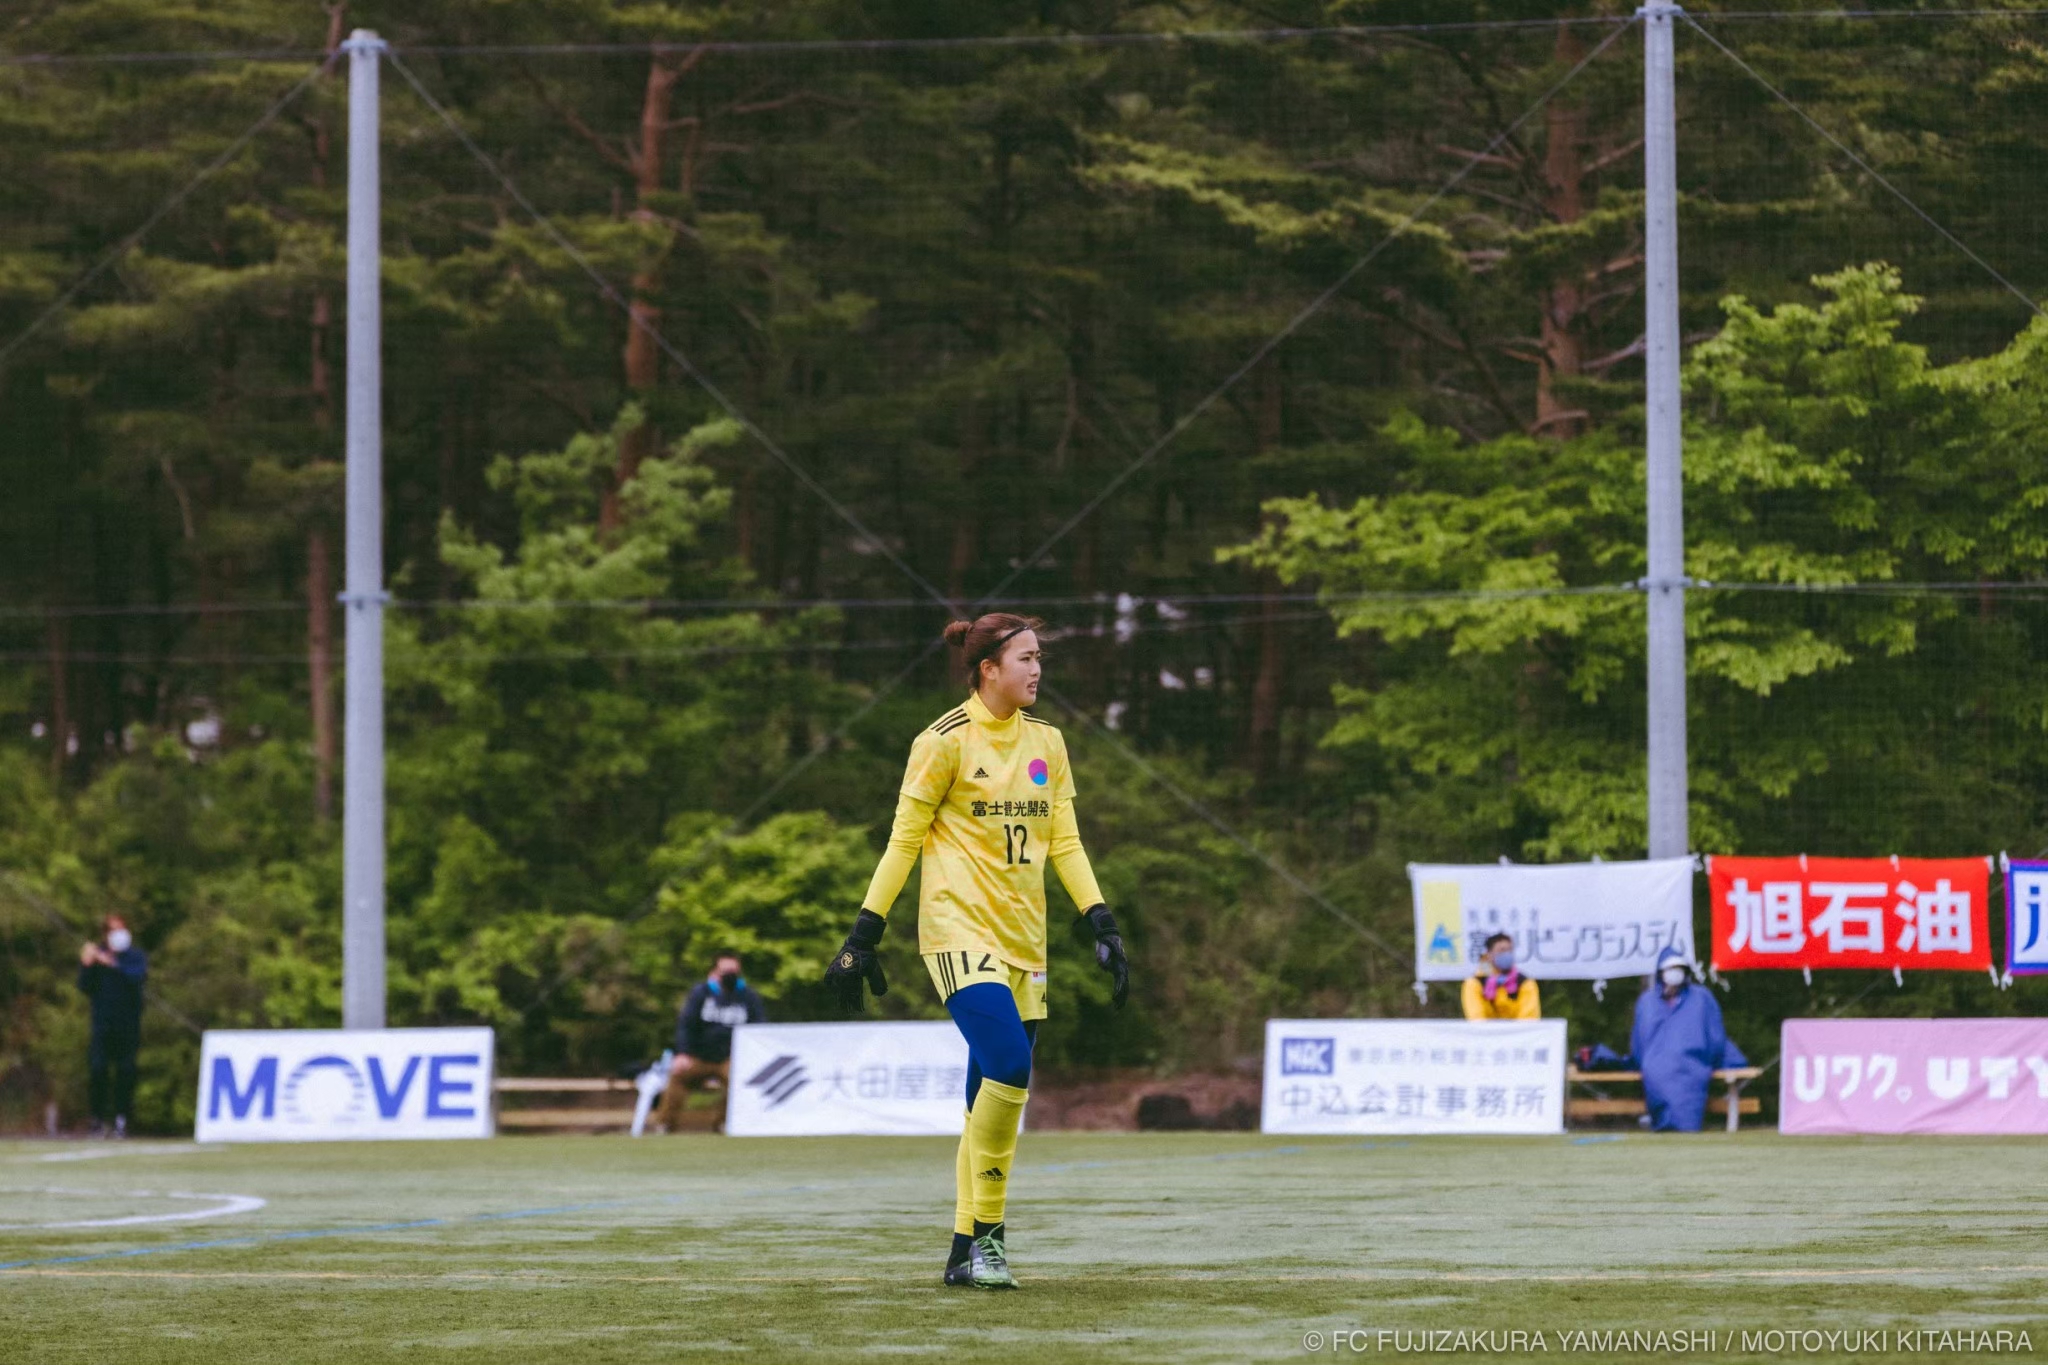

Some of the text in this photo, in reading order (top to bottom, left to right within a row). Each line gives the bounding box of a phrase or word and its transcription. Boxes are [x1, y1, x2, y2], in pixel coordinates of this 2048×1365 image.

[971, 800, 1050, 818] 富士観光開発
[1003, 824, 1031, 865] 12
[1726, 877, 1973, 954] 旭石油
[2022, 885, 2048, 952] j
[1468, 920, 1686, 964] 富リビングシステム
[208, 1055, 480, 1124] MOVE
[1281, 1083, 1546, 1118] 中込会計事務所
